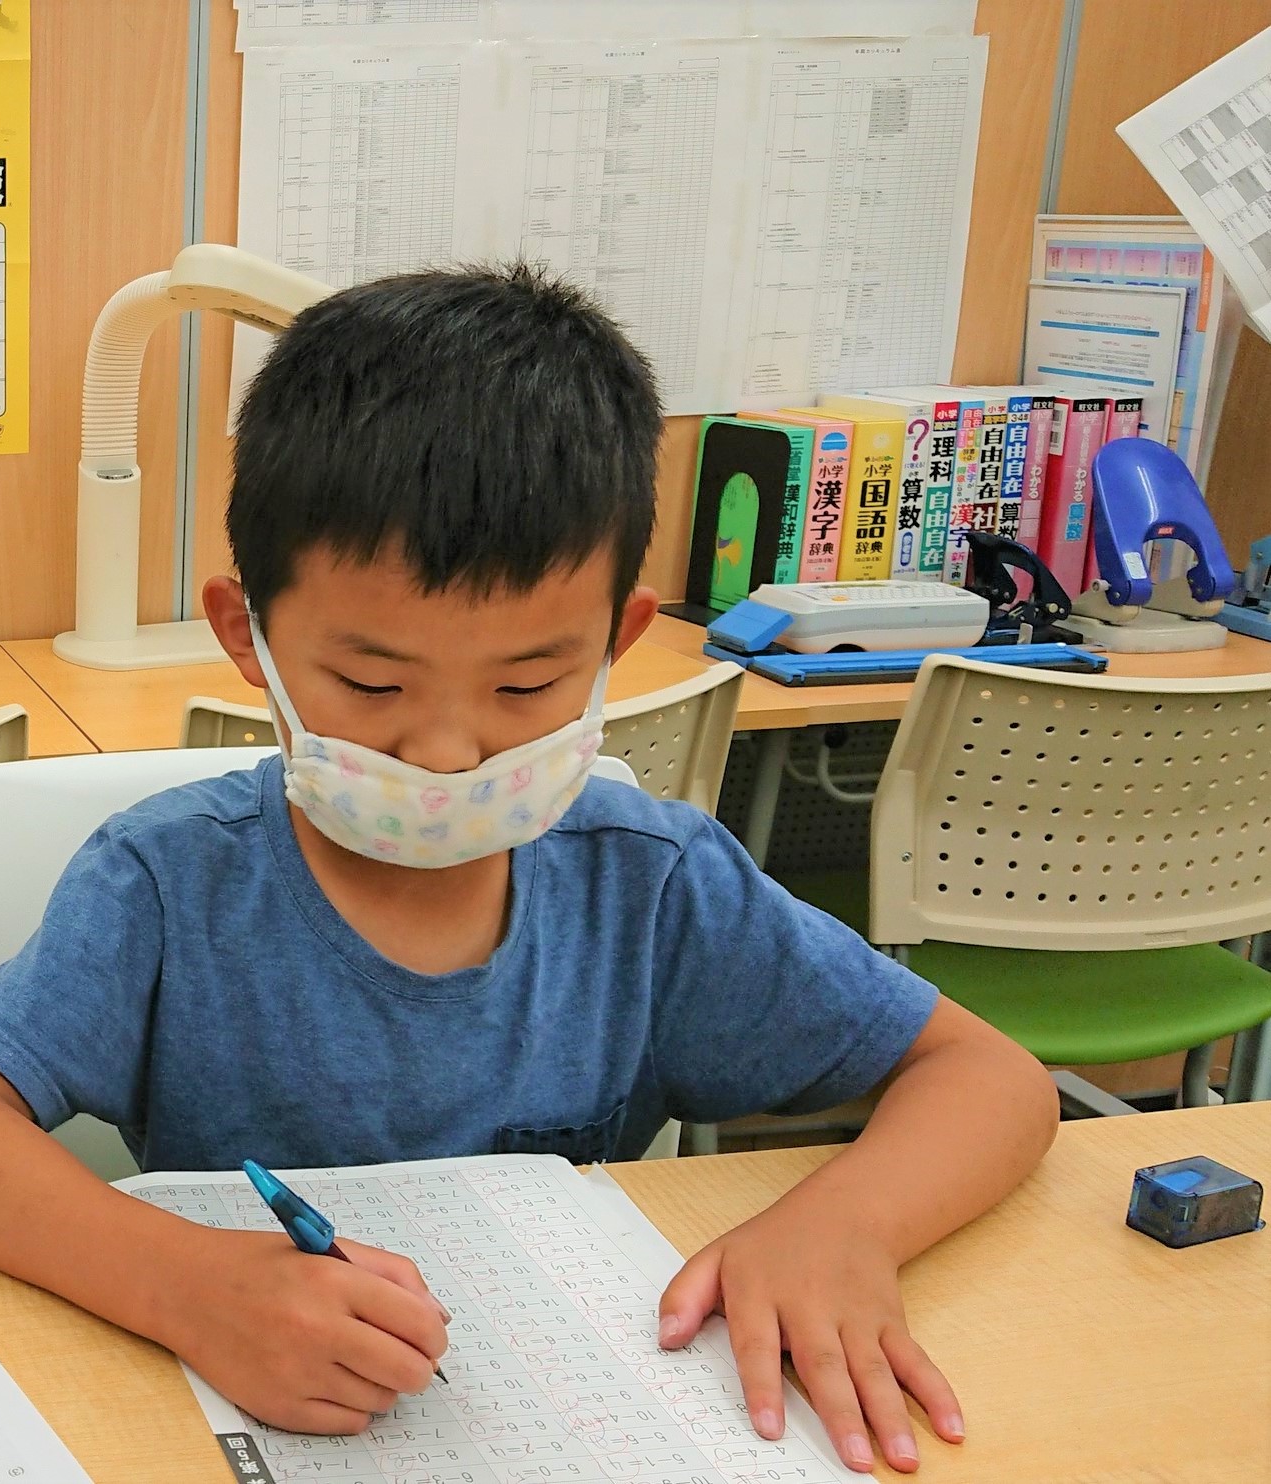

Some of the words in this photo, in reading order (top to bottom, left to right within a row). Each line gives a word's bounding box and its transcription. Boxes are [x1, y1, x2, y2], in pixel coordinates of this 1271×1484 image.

[937, 409, 957, 419] 小学
[988, 405, 1005, 413] 小学
[1012, 403, 1031, 411] 小学
[1033, 401, 1054, 410] 旺文社
[1079, 403, 1100, 411] 旺文社
[1117, 402, 1139, 411] 旺文社
[818, 465, 844, 478] 小学
[863, 464, 892, 477] 小学
[930, 437, 955, 482] 理科
[977, 428, 1004, 500] 自由自在
[1001, 425, 1028, 495] 自由自在
[1028, 466, 1043, 499] わかる
[1073, 468, 1088, 502] わかる
[810, 480, 843, 540] 漢字
[856, 479, 890, 539] 国語
[898, 478, 924, 530] 算数
[922, 491, 948, 566] 自由自在
[948, 503, 974, 548] 漢字
[809, 542, 834, 556] 辞典
[855, 541, 882, 554] 辞典
[226, 1436, 260, 1474] 第5回
